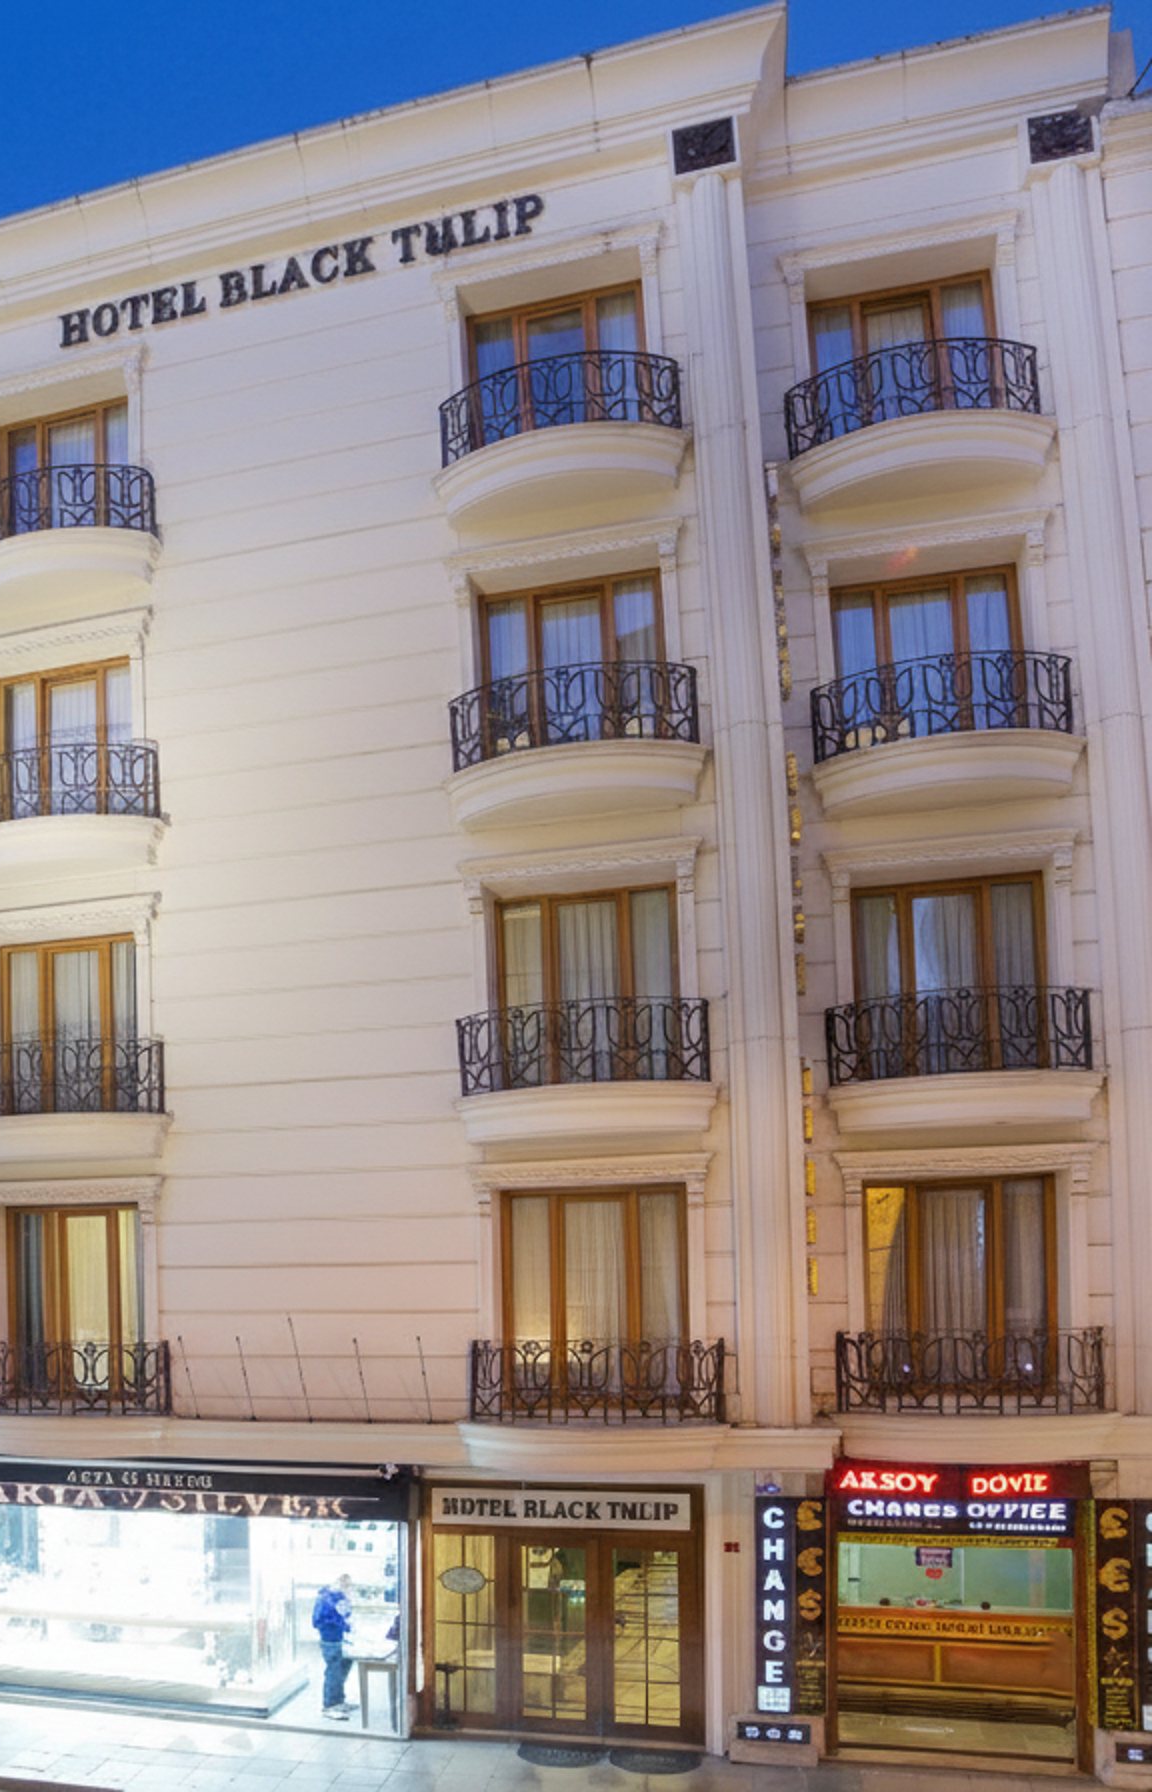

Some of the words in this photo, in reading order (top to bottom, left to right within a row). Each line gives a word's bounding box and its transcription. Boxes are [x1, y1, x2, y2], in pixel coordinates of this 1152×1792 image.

[59, 281, 207, 348] HOTEL
[218, 234, 377, 309] BLACK
[391, 193, 546, 265] TULIP
[762, 1506, 787, 1683] CHANGE
